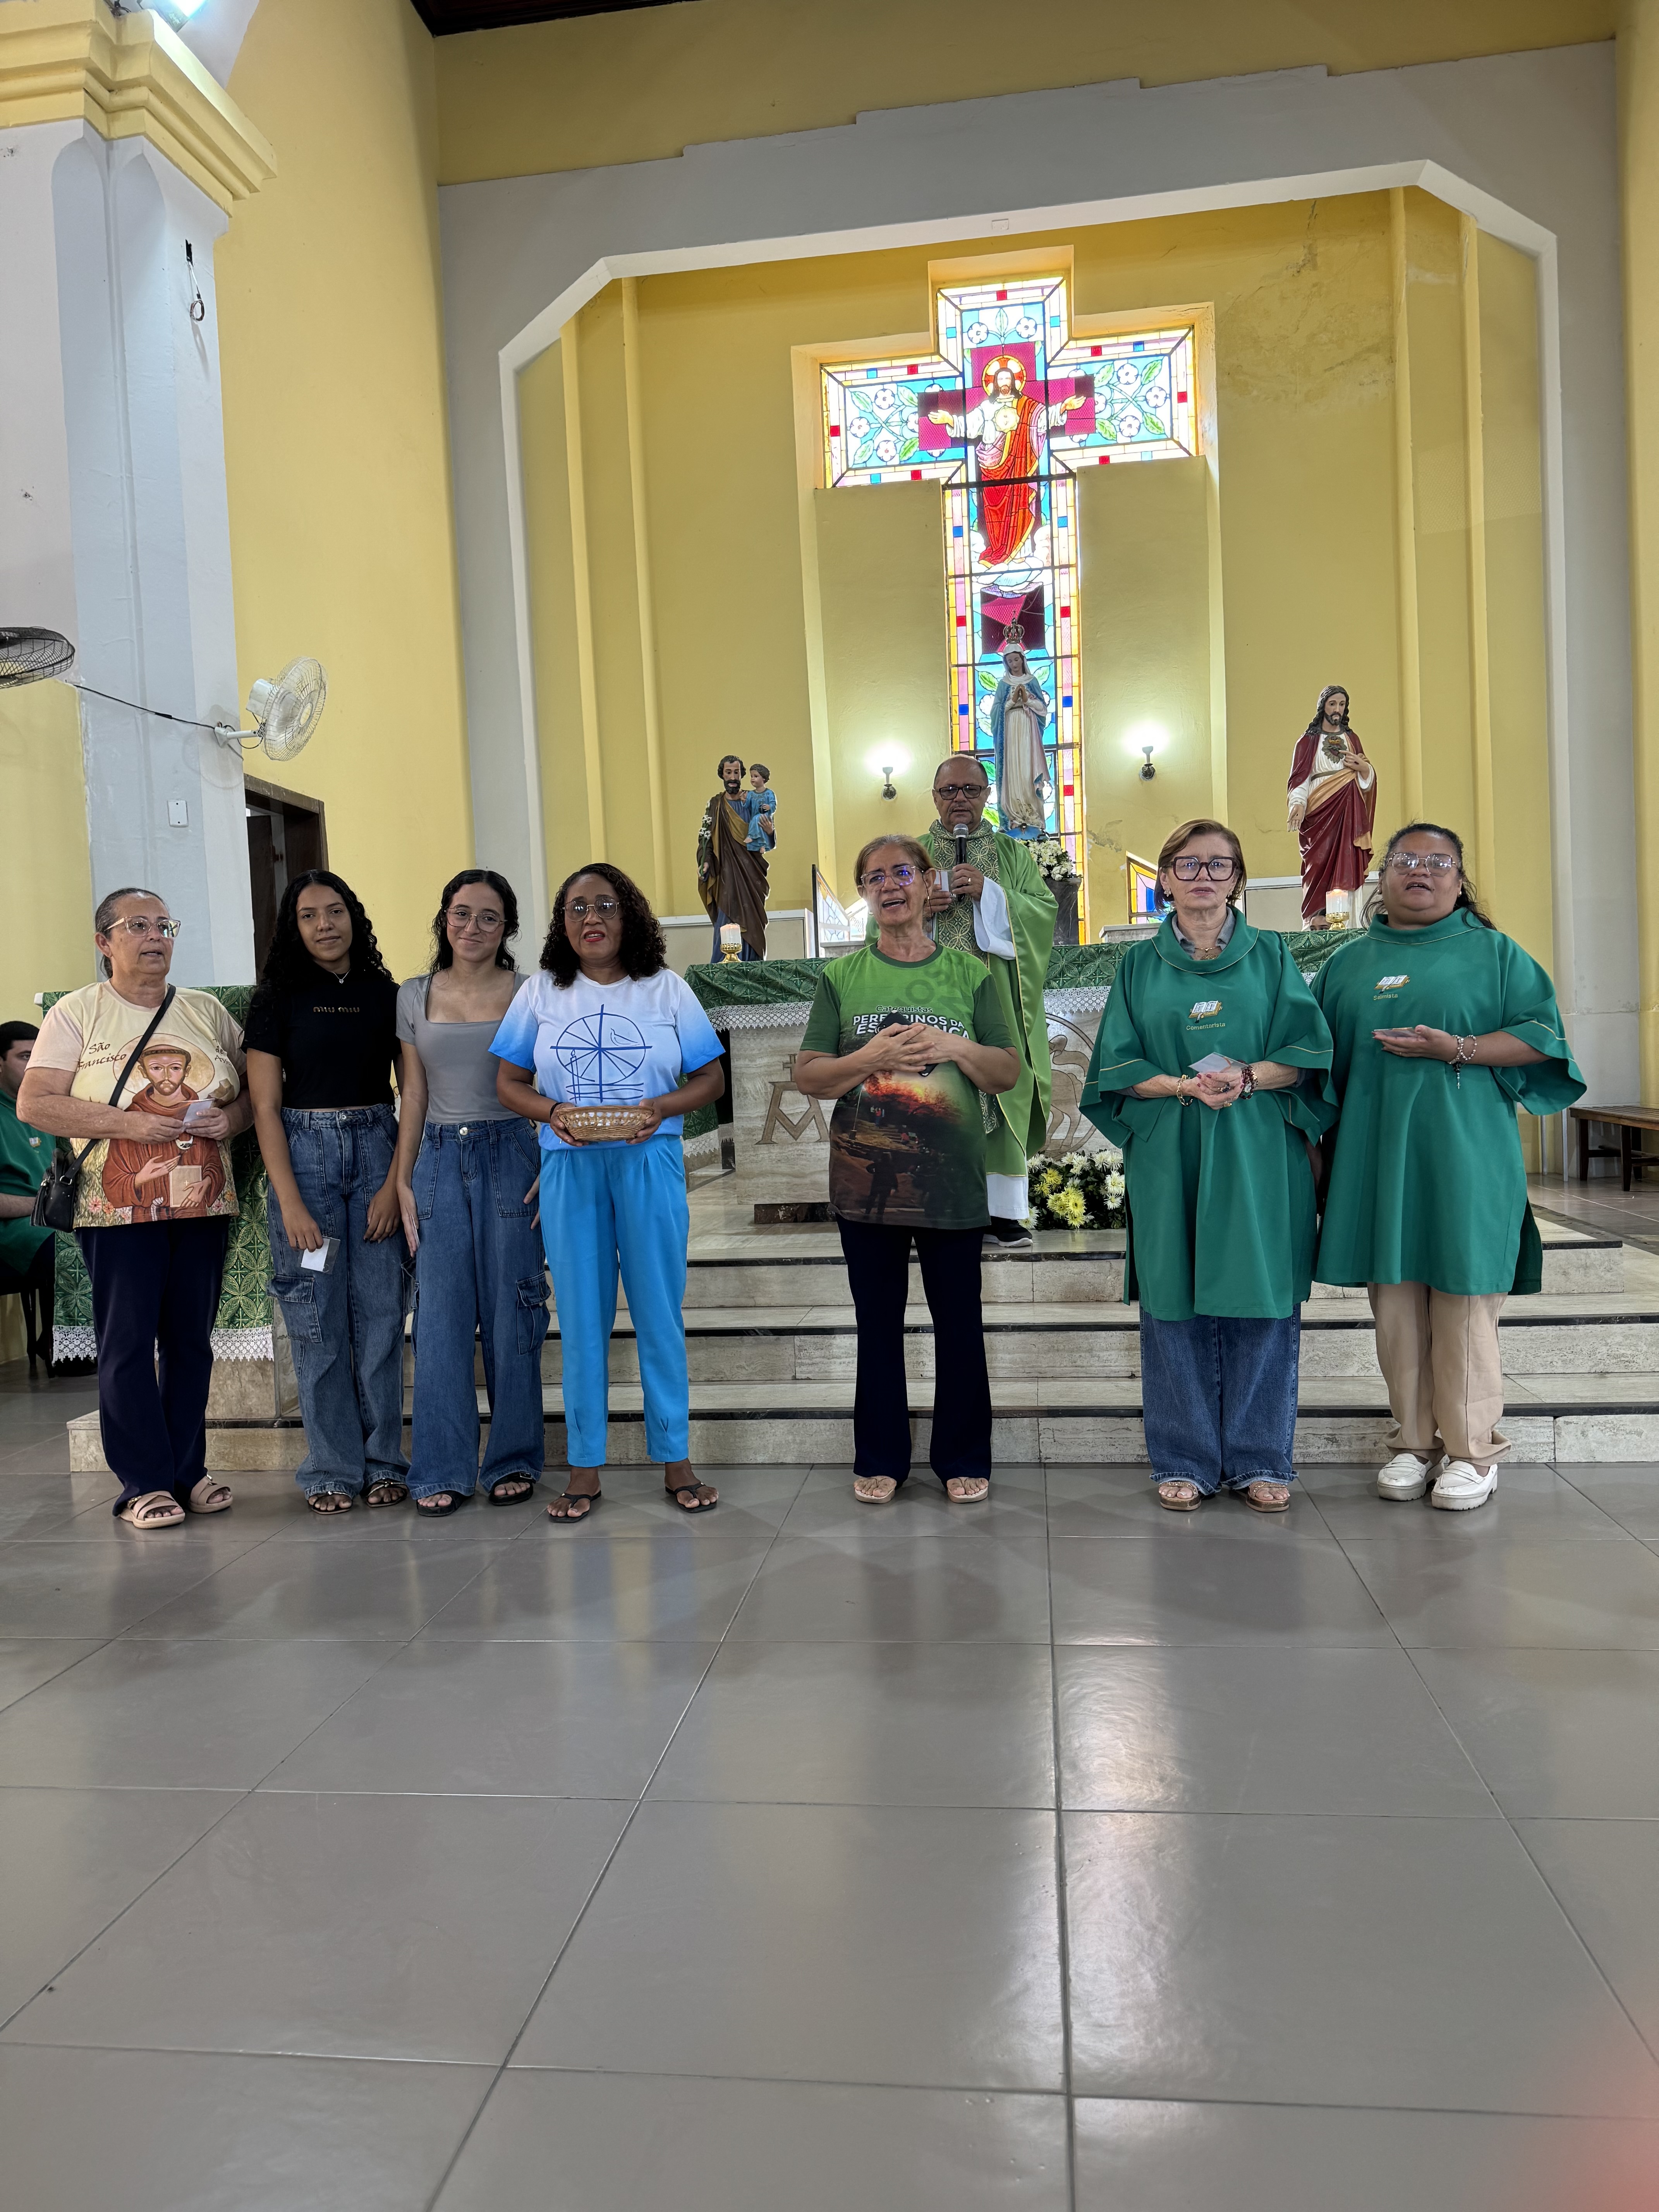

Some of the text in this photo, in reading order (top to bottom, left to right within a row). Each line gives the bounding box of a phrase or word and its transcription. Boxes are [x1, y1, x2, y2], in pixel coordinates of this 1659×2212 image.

[853, 1014, 965, 1029] PEREINOS DA
[89, 1042, 111, 1054] São
[77, 1053, 127, 1073] Francisco
